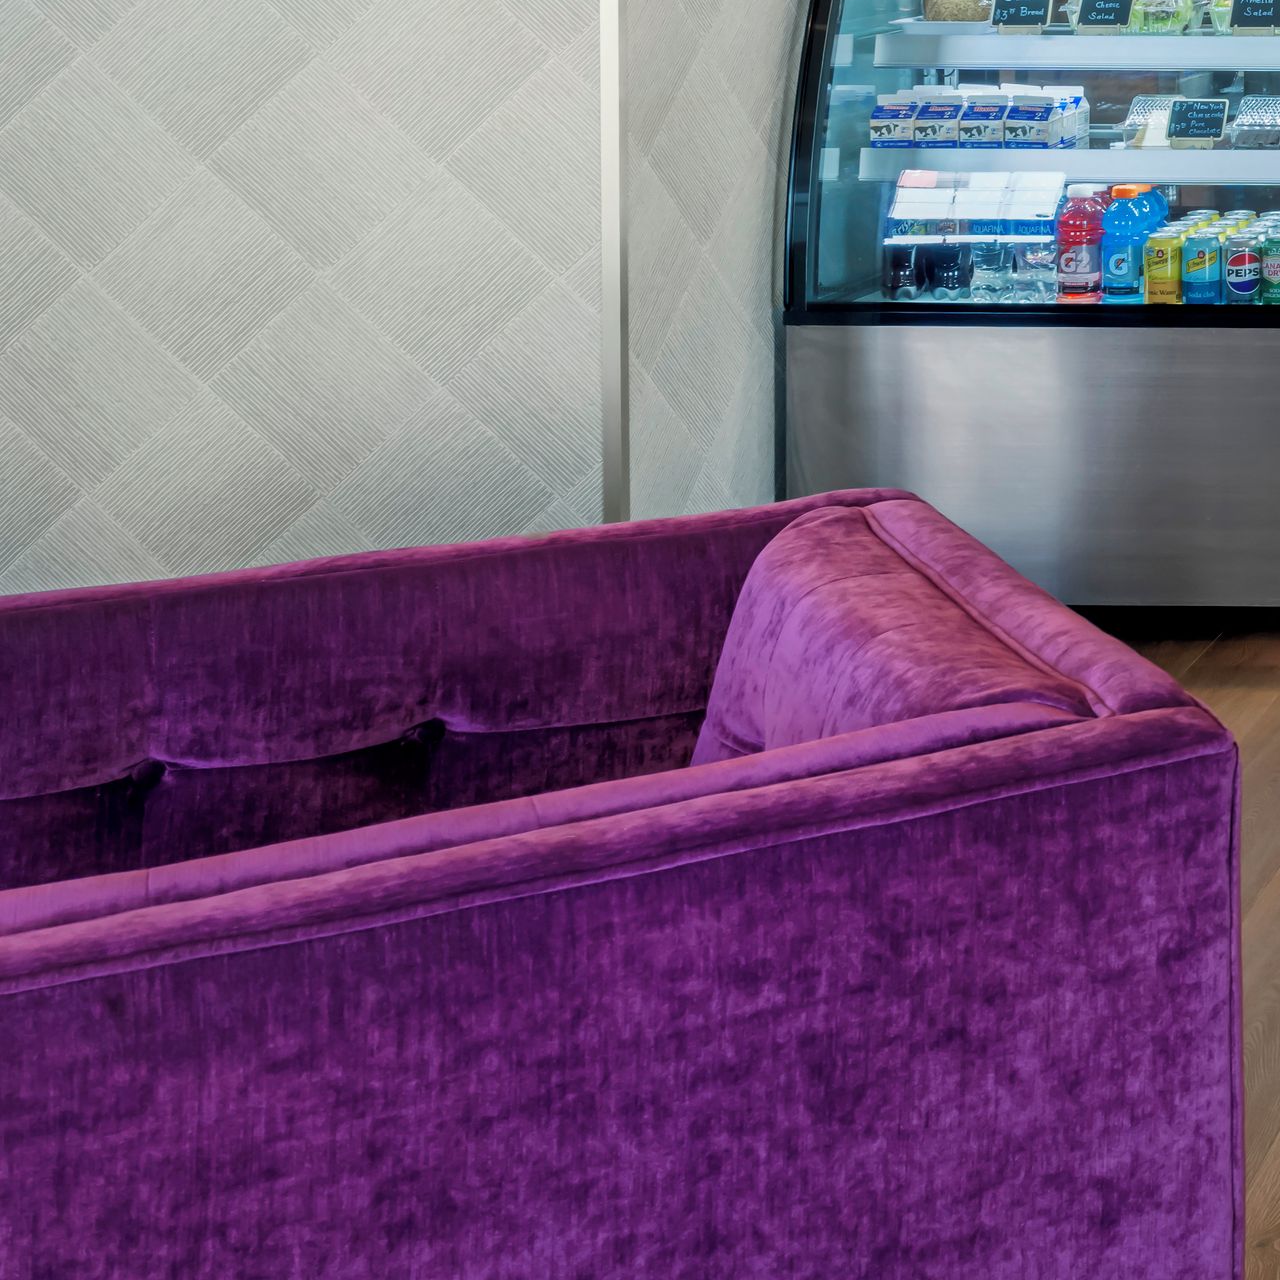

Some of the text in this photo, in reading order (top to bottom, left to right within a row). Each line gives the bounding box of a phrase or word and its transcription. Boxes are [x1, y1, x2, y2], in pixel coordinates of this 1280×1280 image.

[1020, 6, 1045, 17] Bread
[1060, 251, 1091, 273] G2
[1227, 267, 1260, 278] PEPS
